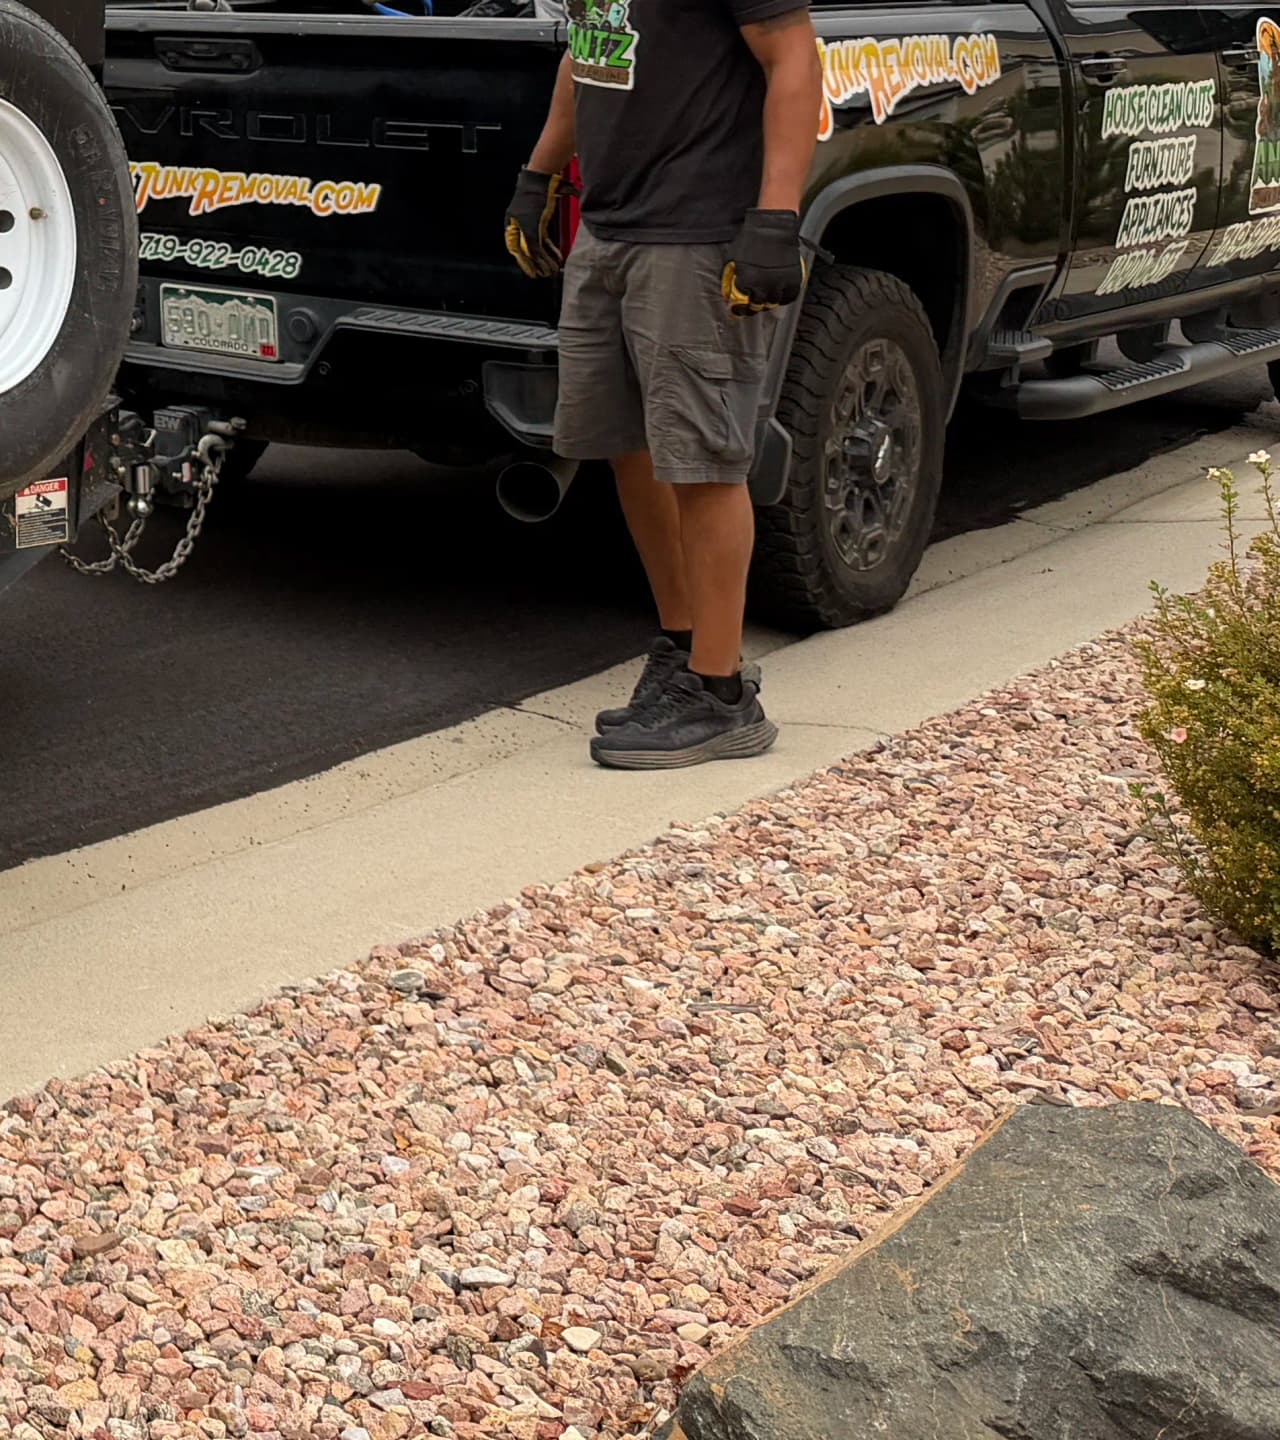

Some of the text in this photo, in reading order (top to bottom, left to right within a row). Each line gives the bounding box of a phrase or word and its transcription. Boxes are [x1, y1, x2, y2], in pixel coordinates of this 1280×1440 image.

[1101, 78, 1216, 140] HOUSE CLEAN OUTS
[130, 162, 382, 217] JUNKREMOVAL.COM
[1124, 134, 1198, 193] FURNITURE
[1116, 187, 1199, 250] APPLIANCES
[138, 232, 304, 280] 719-922-0428
[192, 336, 249, 352] COLORADO
[30, 482, 60, 494] DANGER
